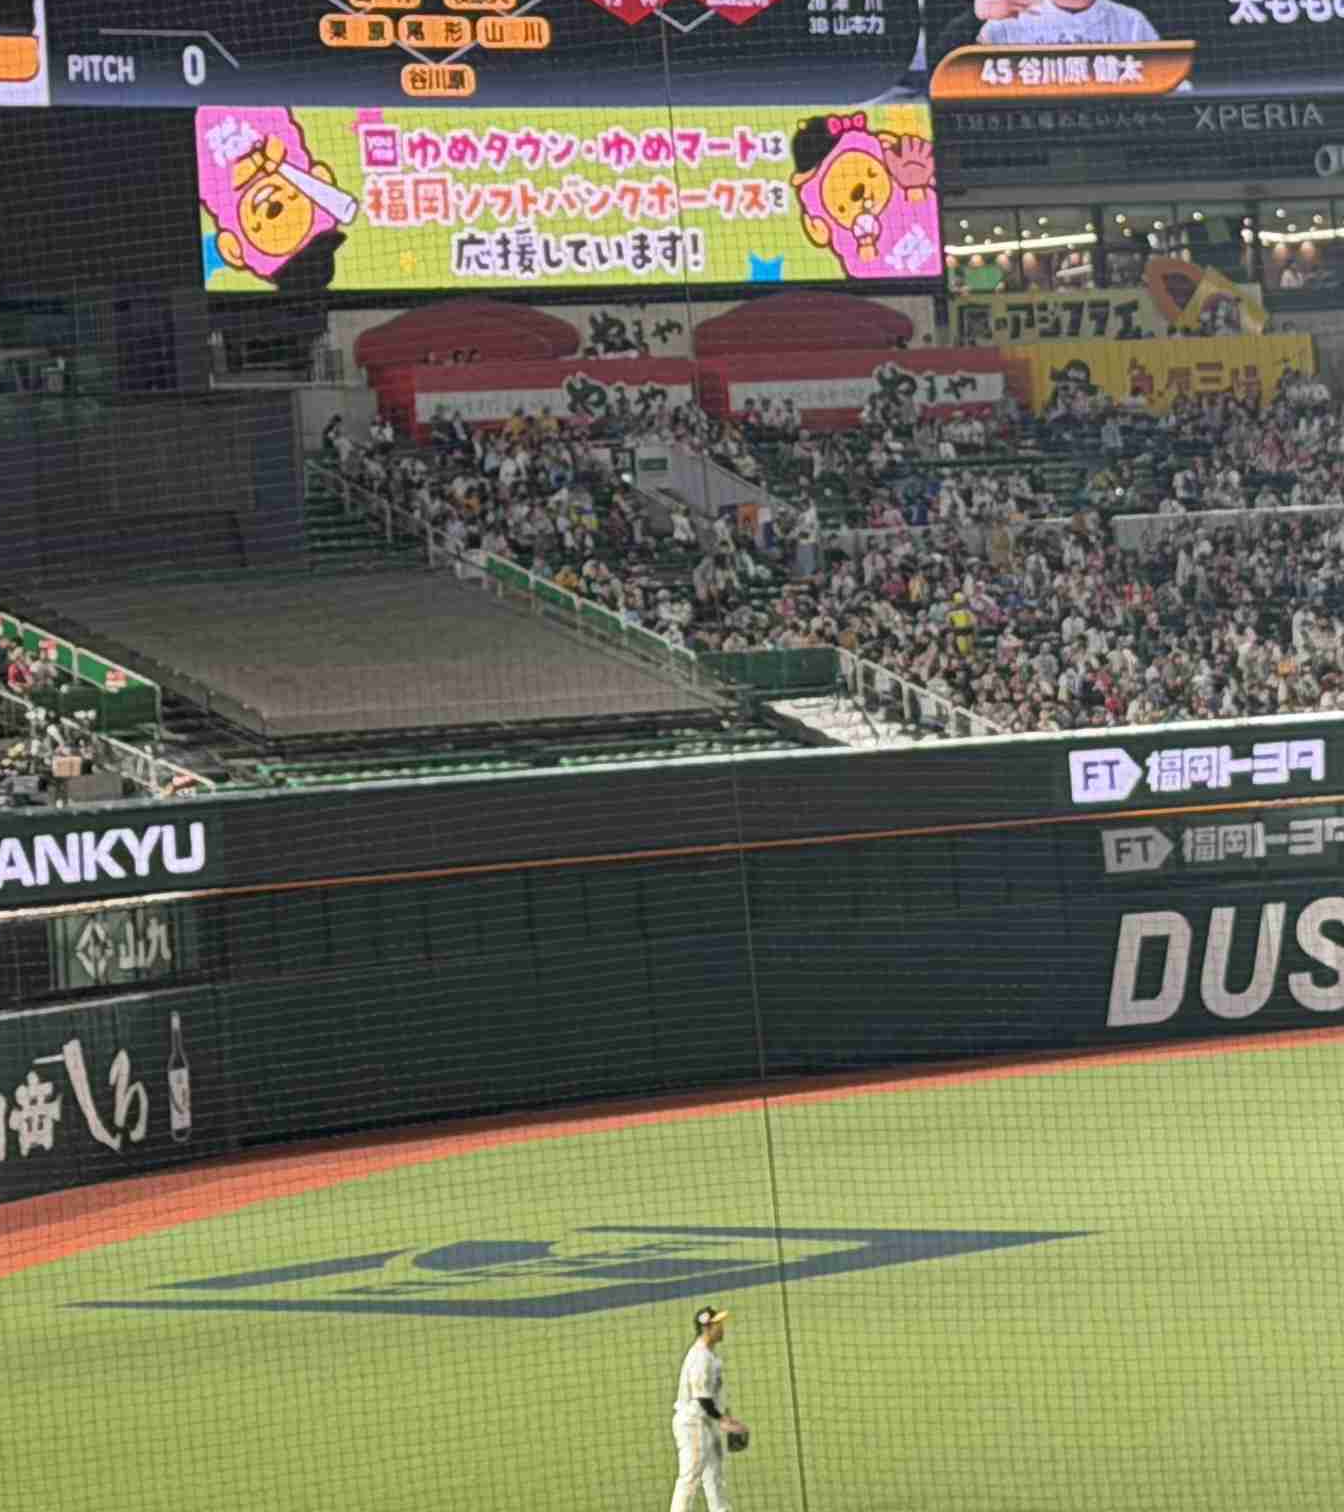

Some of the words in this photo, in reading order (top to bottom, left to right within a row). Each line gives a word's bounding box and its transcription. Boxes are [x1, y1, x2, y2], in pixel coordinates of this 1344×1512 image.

[67, 54, 136, 83] PITCH
[183, 44, 206, 86] 0
[981, 57, 1013, 85] 45
[1018, 55, 1089, 85] 谷川原
[1192, 103, 1325, 130] XPERIA
[1146, 738, 1325, 793] 福岡トヨタ
